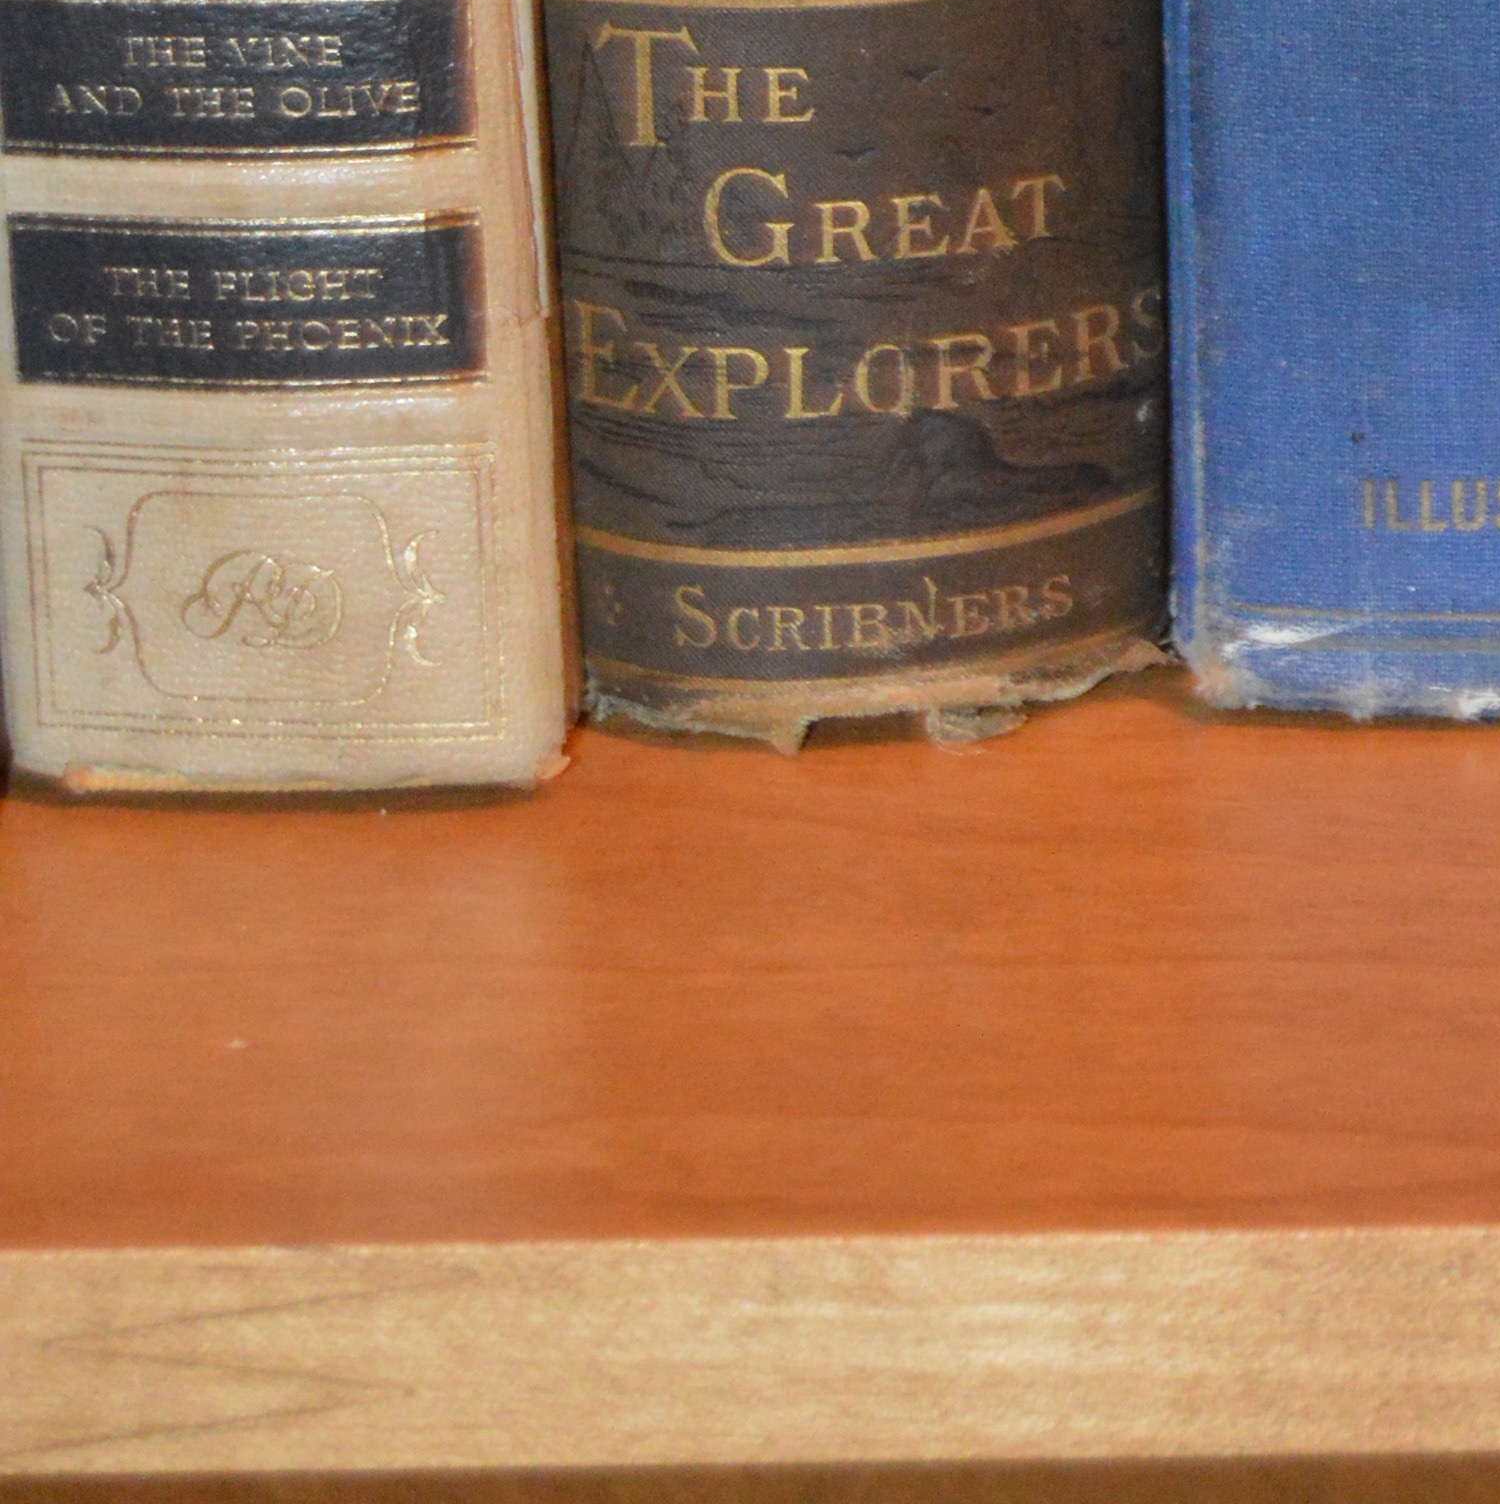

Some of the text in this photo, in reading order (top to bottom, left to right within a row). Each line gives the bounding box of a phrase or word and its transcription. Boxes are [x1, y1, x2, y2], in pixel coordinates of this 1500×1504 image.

[123, 35, 342, 69] THE VINE
[49, 81, 420, 118] AND THE OLIVE
[595, 22, 815, 149] THE
[704, 165, 1065, 268] GREAT
[104, 266, 384, 301] THE FLIGHT
[51, 313, 449, 352] OF THE PHOENIX
[572, 288, 1163, 422] EXPLORERS
[673, 575, 1073, 652] SCRIBNERS
